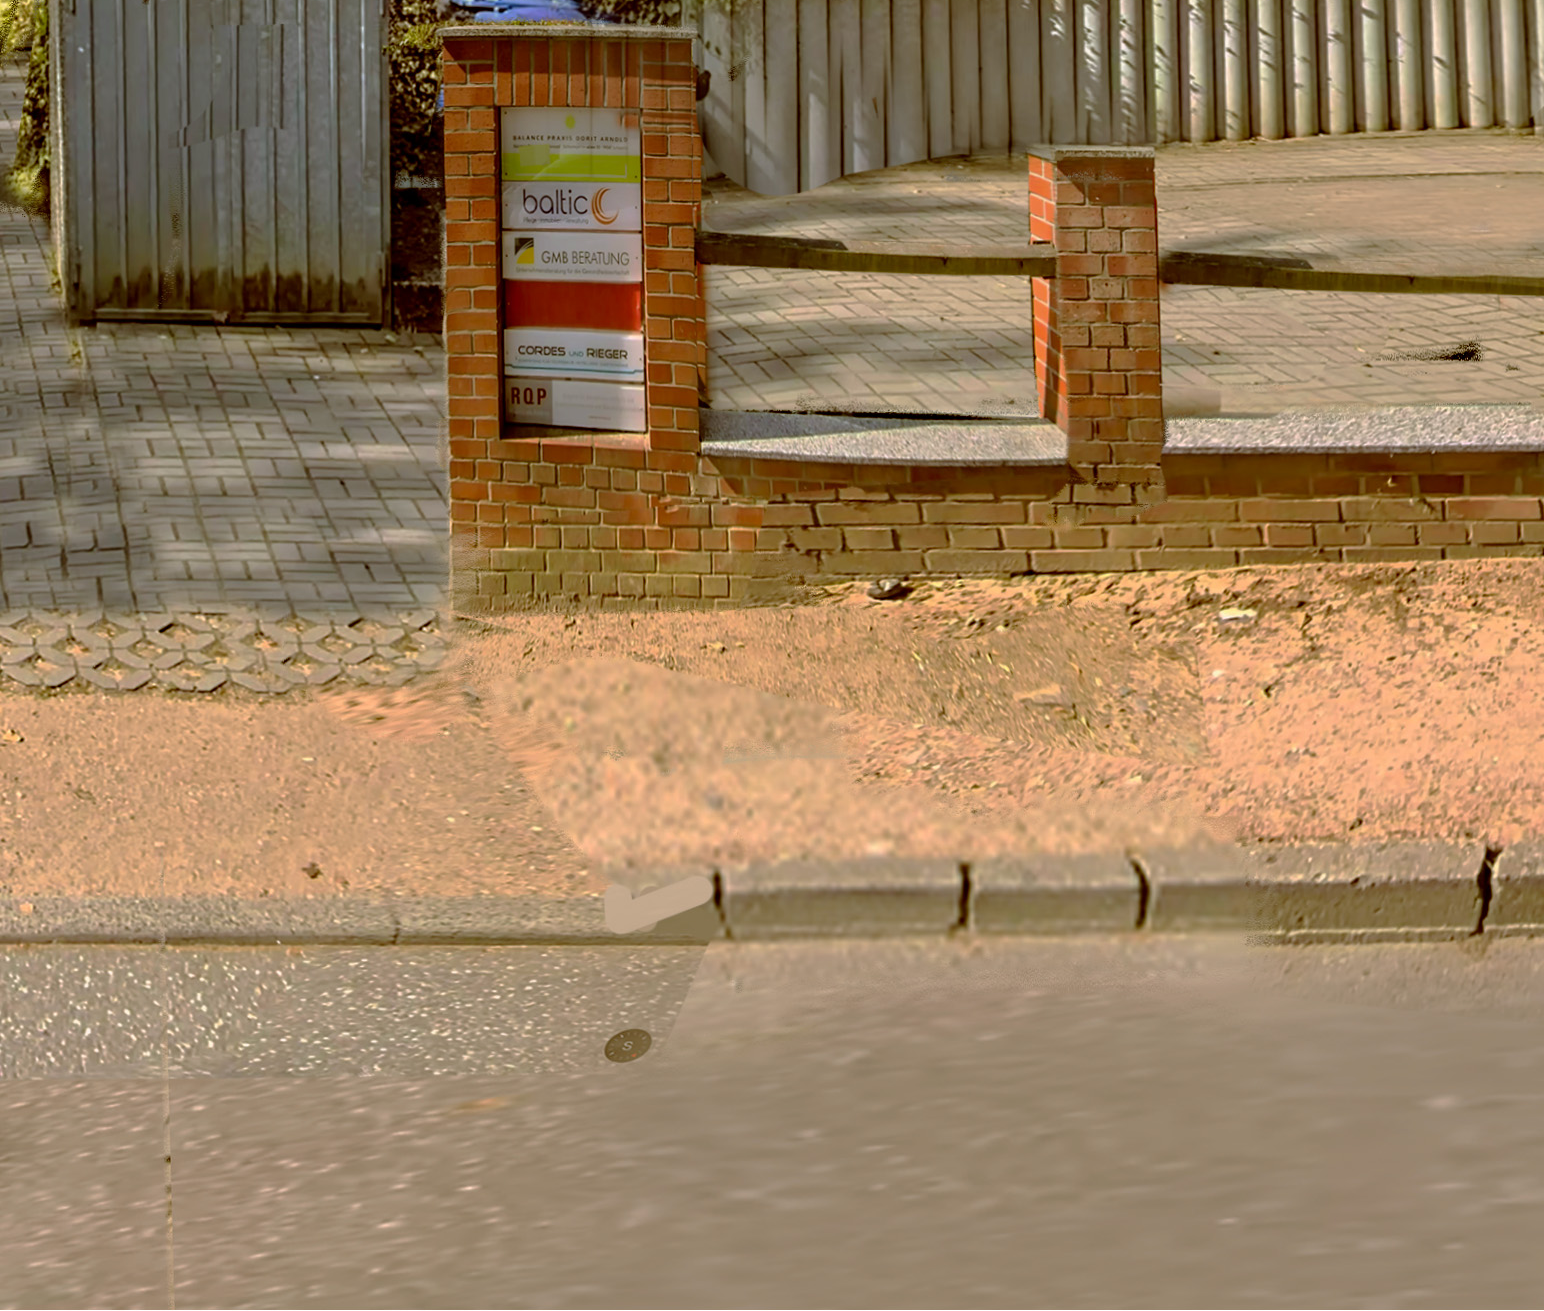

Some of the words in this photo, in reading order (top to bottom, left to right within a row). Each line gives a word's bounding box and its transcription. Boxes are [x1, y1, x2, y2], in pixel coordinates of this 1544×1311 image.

[522, 188, 588, 215] baltic
[541, 250, 568, 264] GMB
[571, 251, 630, 266] BERATUNG
[517, 345, 566, 356] CORDES
[586, 347, 628, 360] RIEGER
